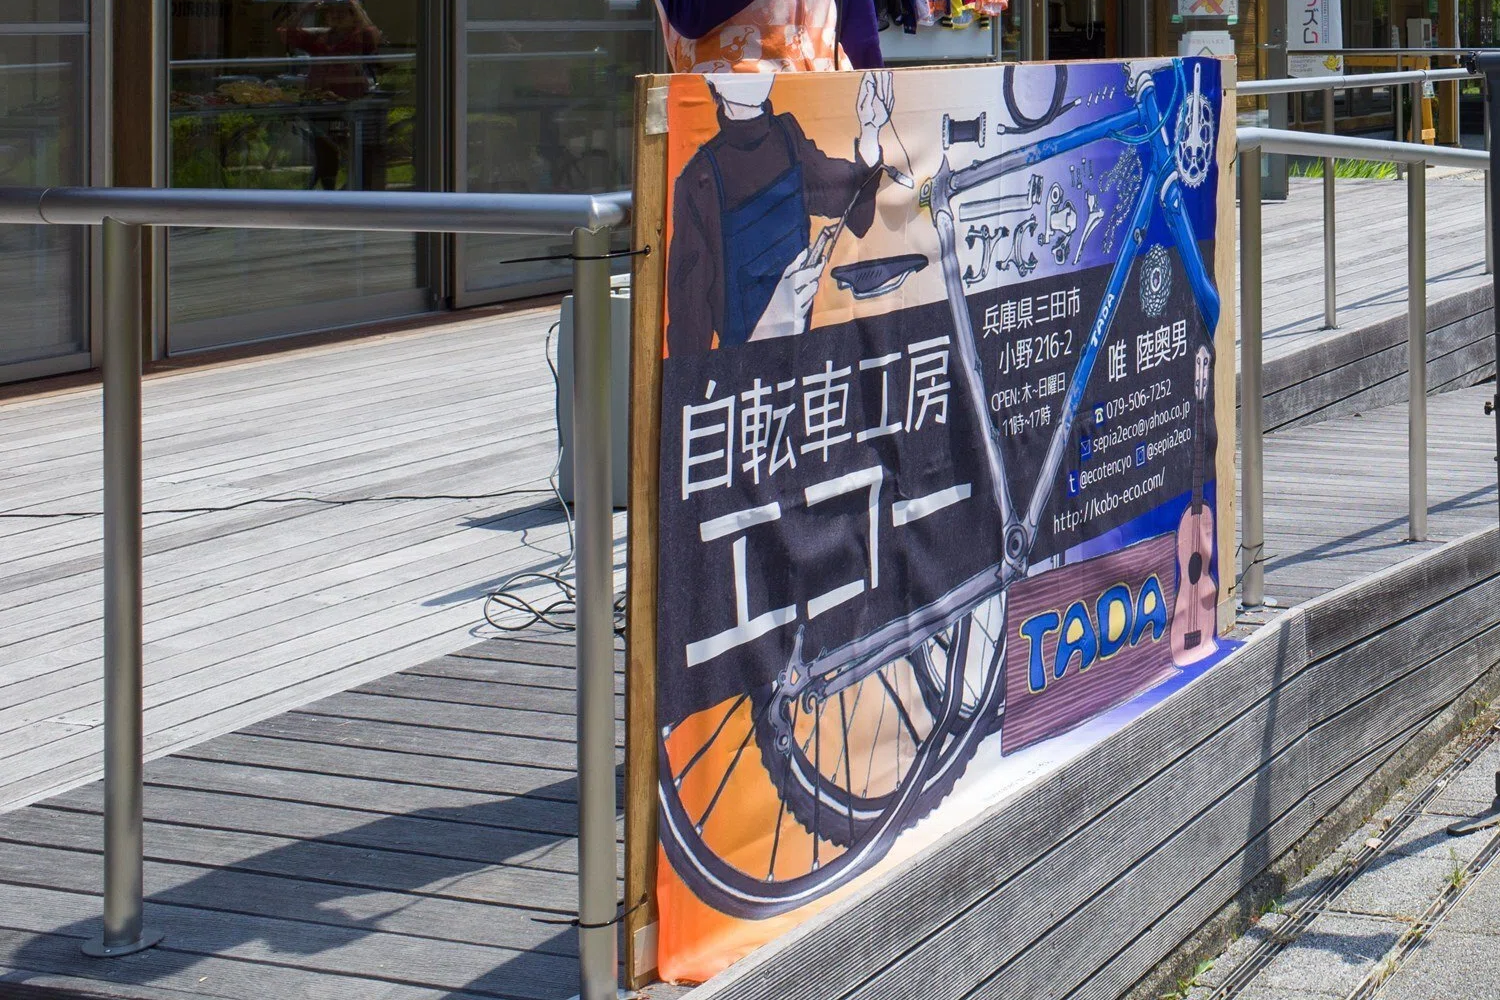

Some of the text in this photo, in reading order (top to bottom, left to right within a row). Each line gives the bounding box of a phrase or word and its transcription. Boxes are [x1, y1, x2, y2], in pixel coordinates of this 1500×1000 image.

[983, 286, 1081, 339] 兵庫県三田市
[1090, 293, 1116, 347] TADA
[1107, 319, 1188, 383] 唯 陸奥男
[682, 335, 951, 500] 自転車工房
[1093, 398, 1191, 453] sepia2eco@yahoo.co.jp
[1106, 378, 1172, 420] 079-506-7252
[1079, 454, 1132, 489] @ecotencyo
[1146, 428, 1192, 460] @sepia2eco
[1053, 466, 1166, 534] http://kobo-eco.com/
[686, 465, 972, 668] エコー
[1018, 573, 1168, 694] TADA
